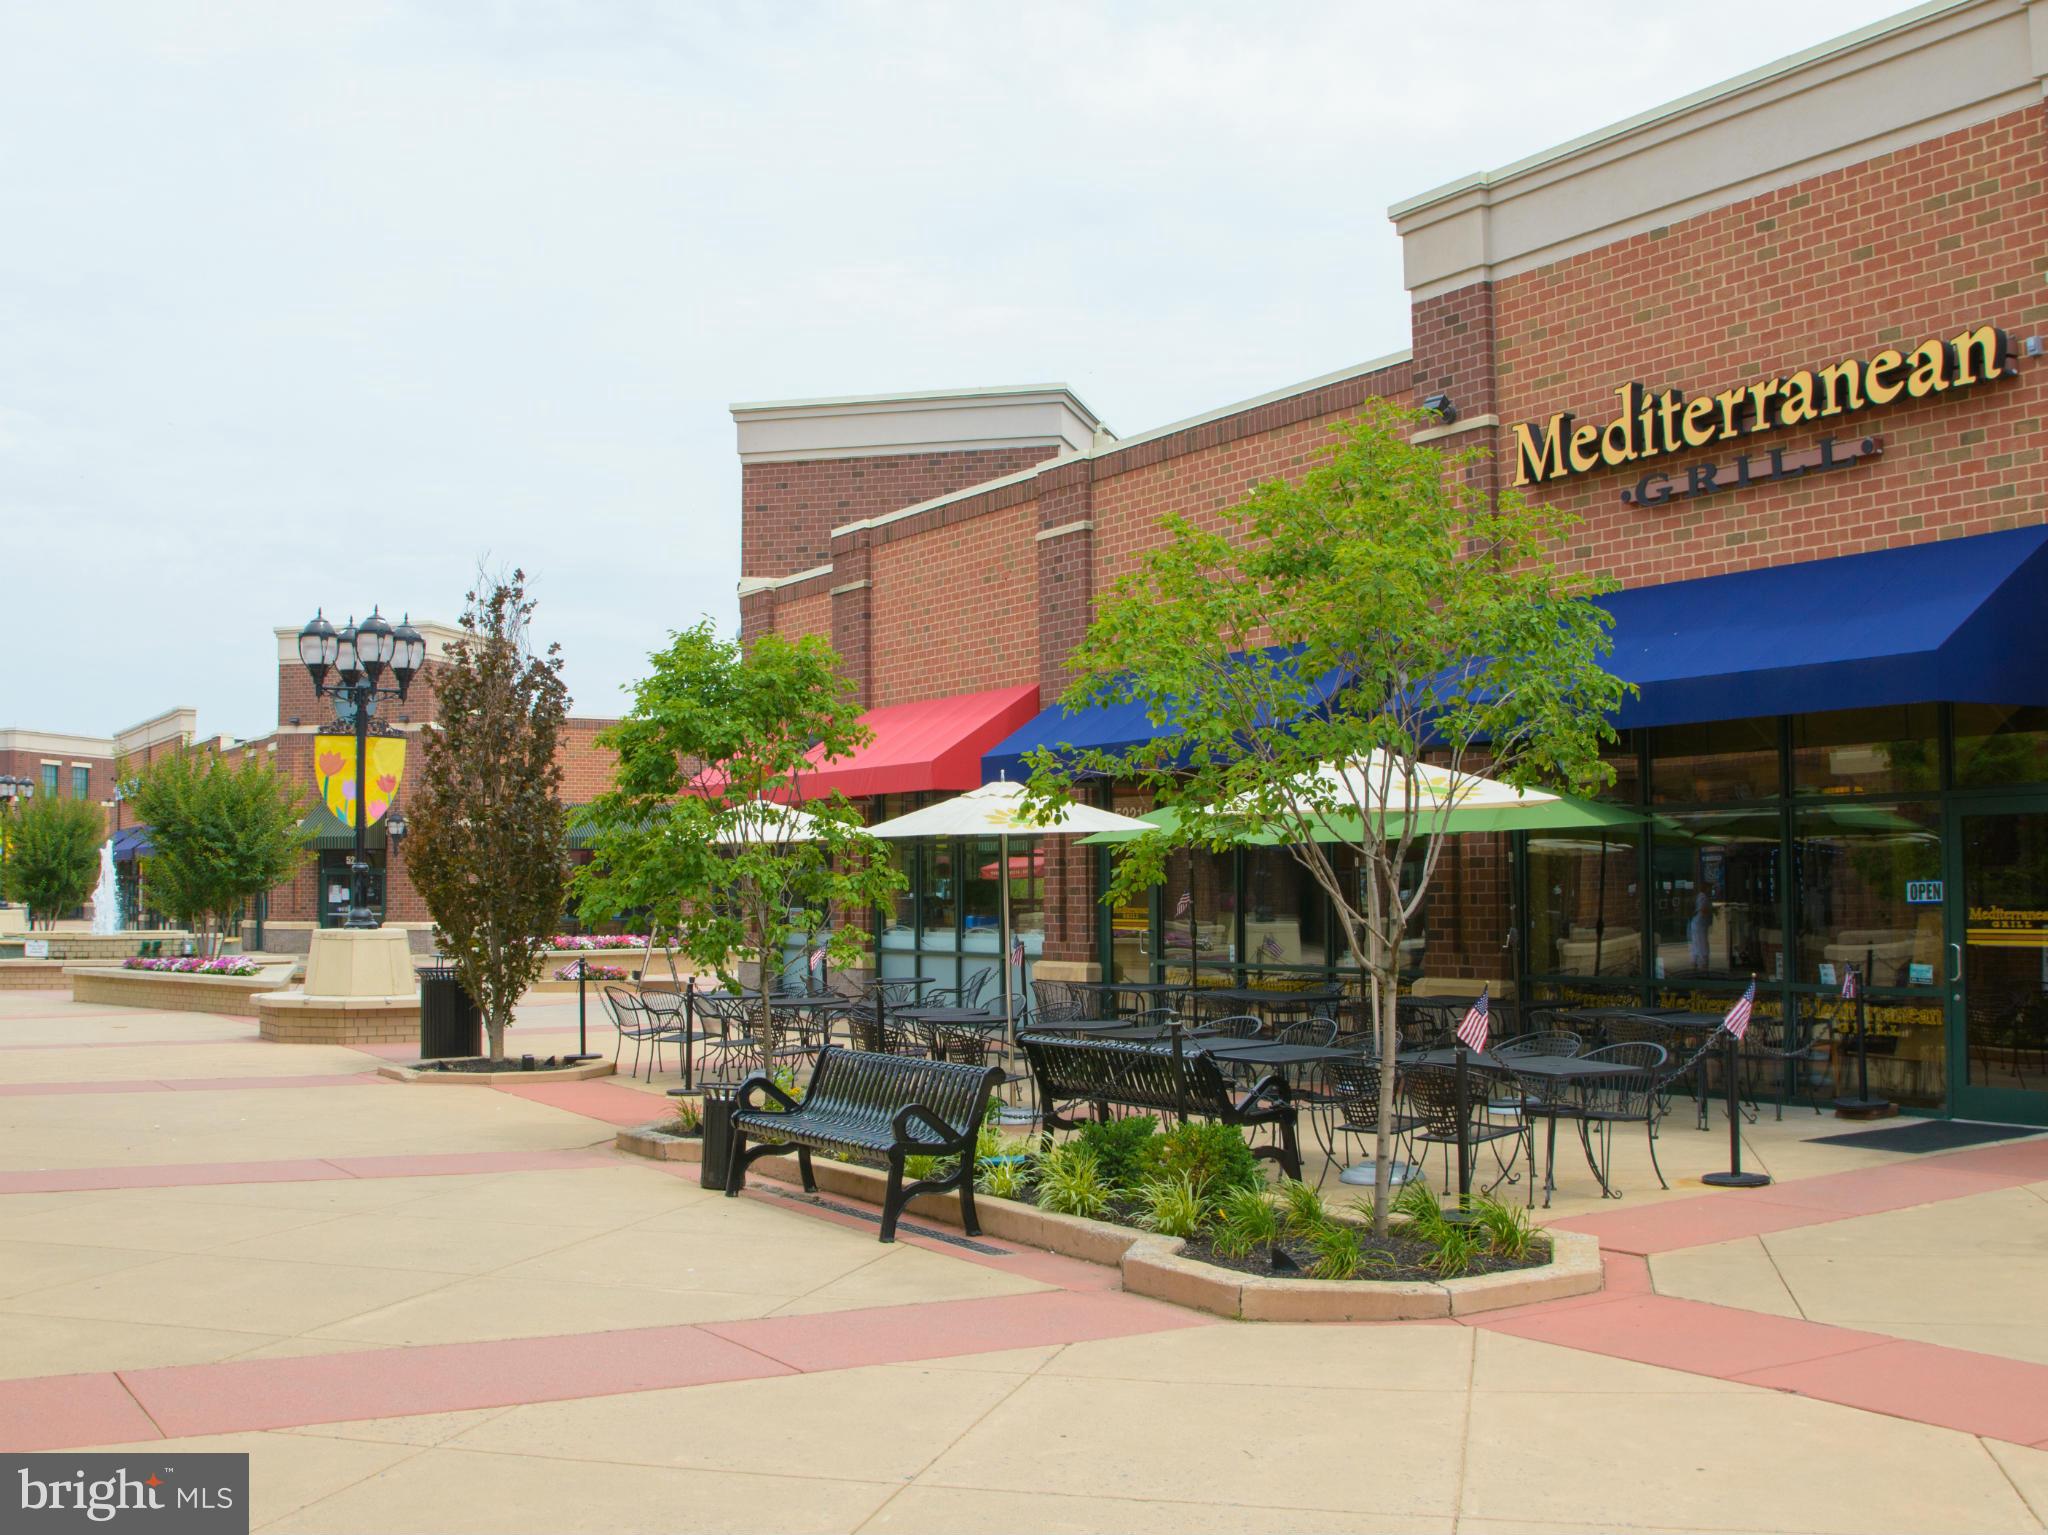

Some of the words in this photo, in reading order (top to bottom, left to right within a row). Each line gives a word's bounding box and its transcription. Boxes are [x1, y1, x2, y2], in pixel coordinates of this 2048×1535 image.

[1512, 324, 2004, 487] Mediterranean
[1635, 436, 1857, 508] GRILL
[1910, 883, 1941, 900] OPEN
